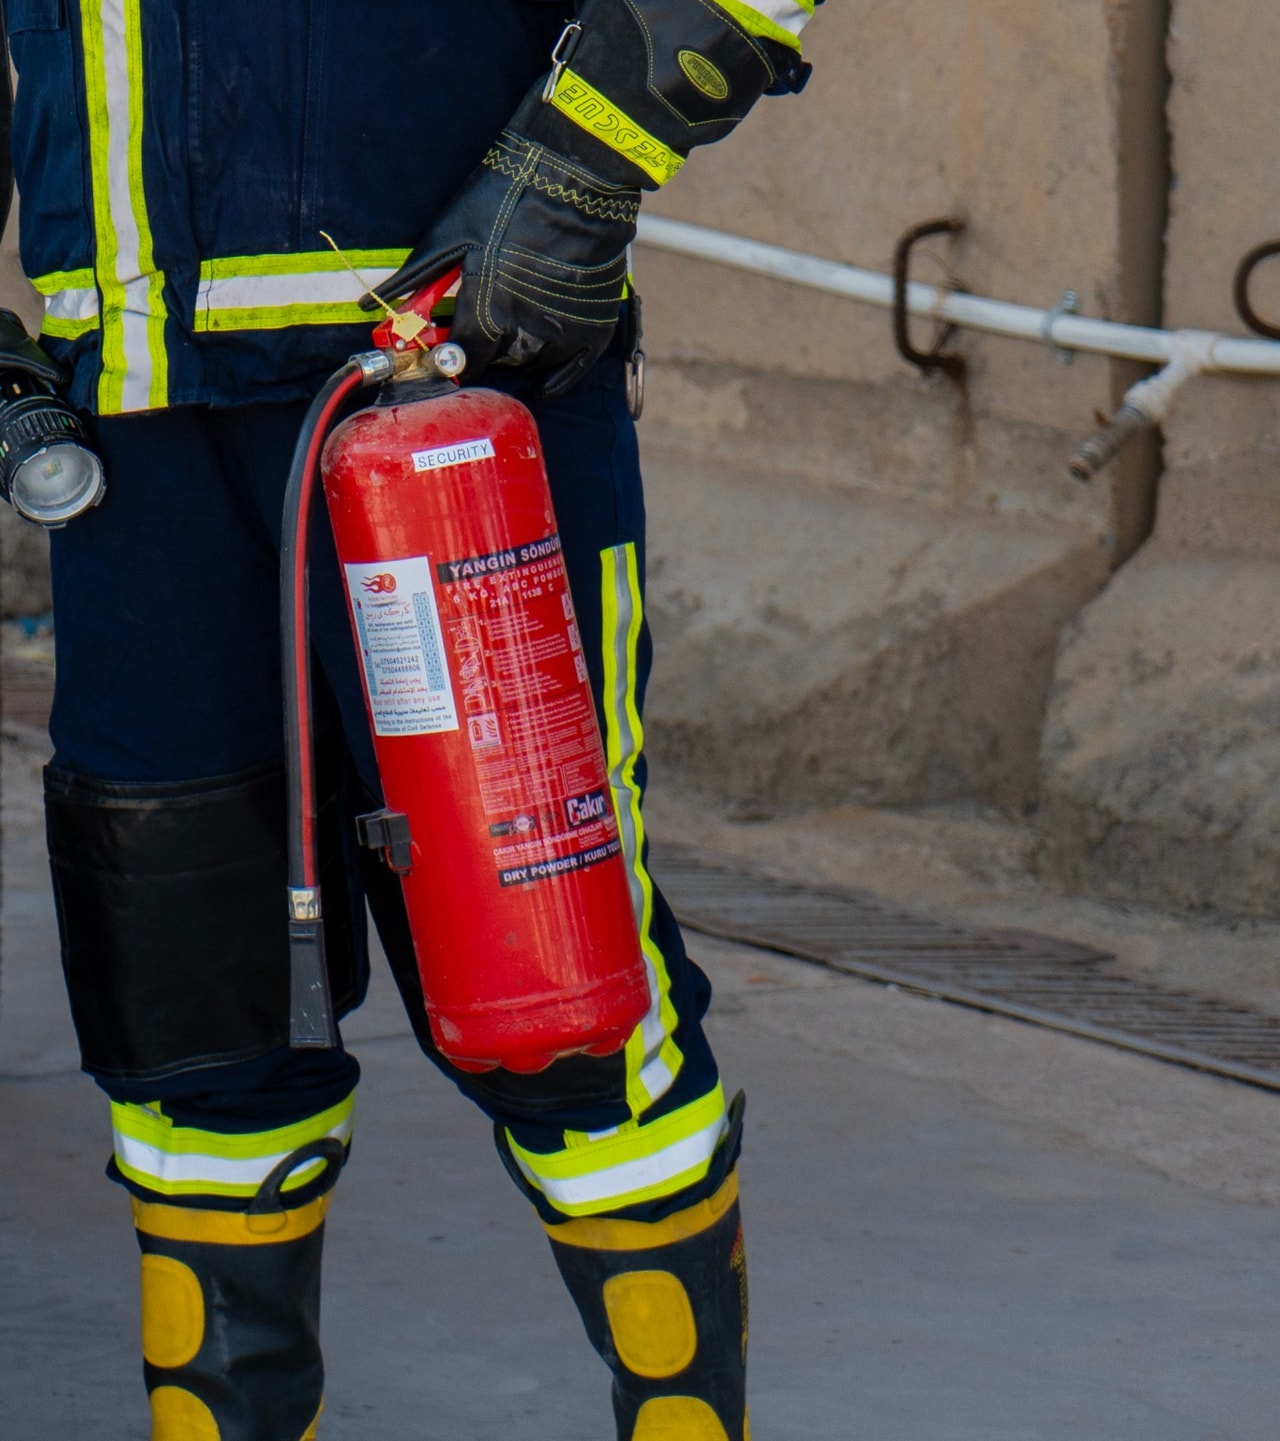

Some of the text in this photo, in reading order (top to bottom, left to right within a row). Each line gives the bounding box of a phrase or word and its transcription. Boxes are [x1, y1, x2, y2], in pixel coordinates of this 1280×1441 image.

[418, 443, 488, 468] SECURITY
[449, 552, 517, 578] YANGIN
[446, 578, 481, 593] FIRE
[503, 581, 528, 593] ABC
[490, 597, 509, 608] 21A
[503, 869, 528, 883] DRY
[531, 856, 578, 877] POWDER
[584, 846, 607, 863] KURU
